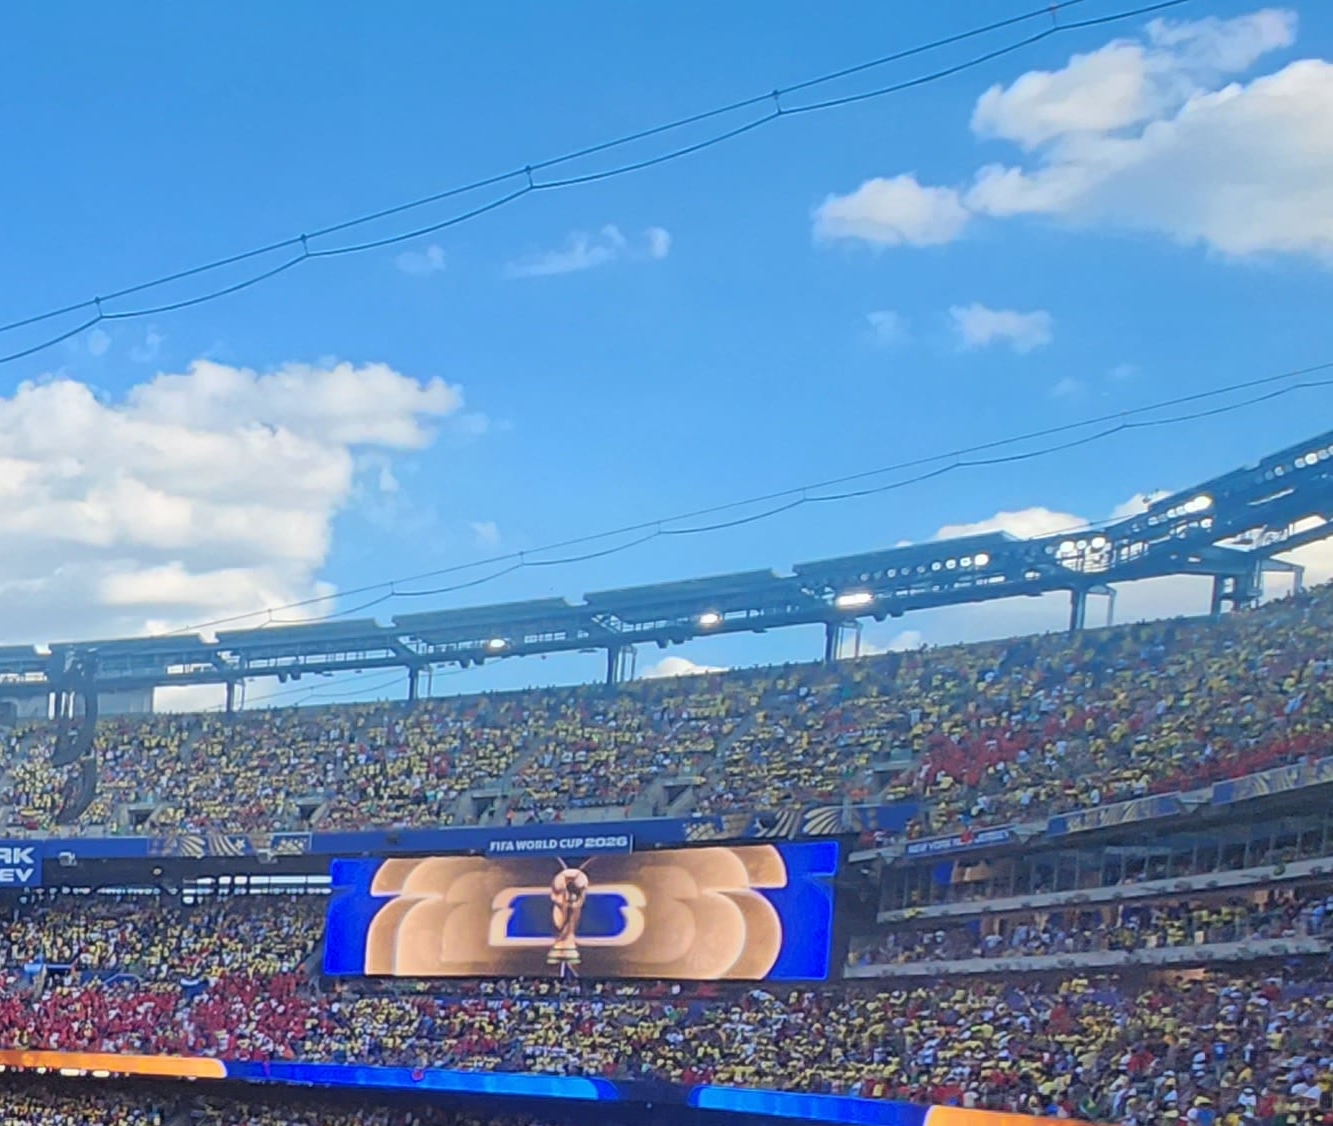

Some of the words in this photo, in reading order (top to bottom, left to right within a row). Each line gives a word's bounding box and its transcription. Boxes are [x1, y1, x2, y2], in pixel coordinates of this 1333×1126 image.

[489, 840, 515, 852] FIFA
[516, 838, 557, 851] WORLD
[559, 837, 583, 849] CUP
[584, 836, 628, 848] 2026
